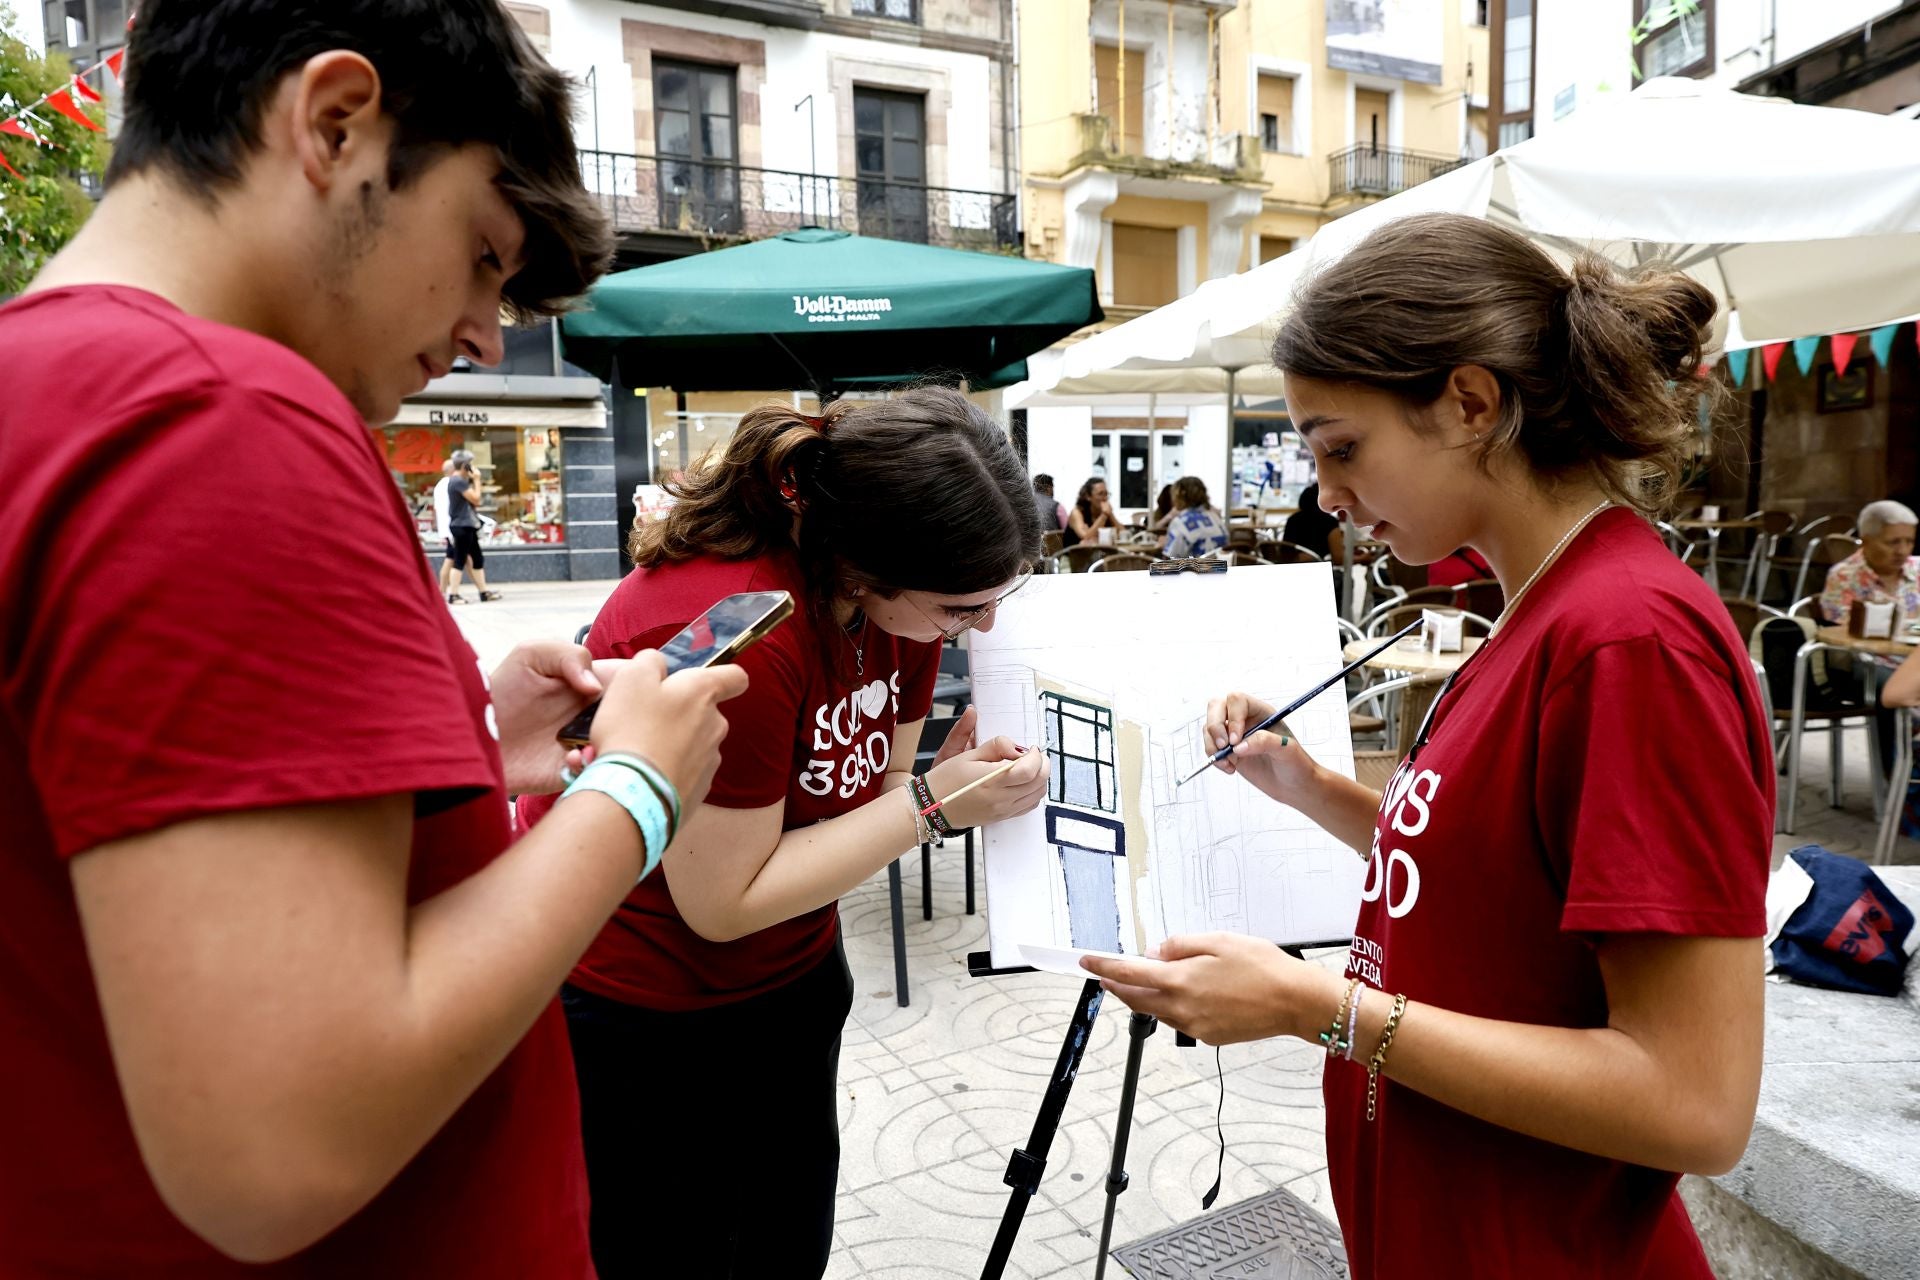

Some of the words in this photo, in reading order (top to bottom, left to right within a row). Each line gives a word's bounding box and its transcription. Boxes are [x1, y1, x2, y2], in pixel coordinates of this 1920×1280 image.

[792, 295, 893, 316] Voll-Damm
[808, 314, 845, 323] DOBLE
[846, 313, 881, 321] MALTA
[917, 784, 938, 818] Grane
[1351, 935, 1383, 964] IENTO
[1344, 954, 1383, 989] AVEGA
